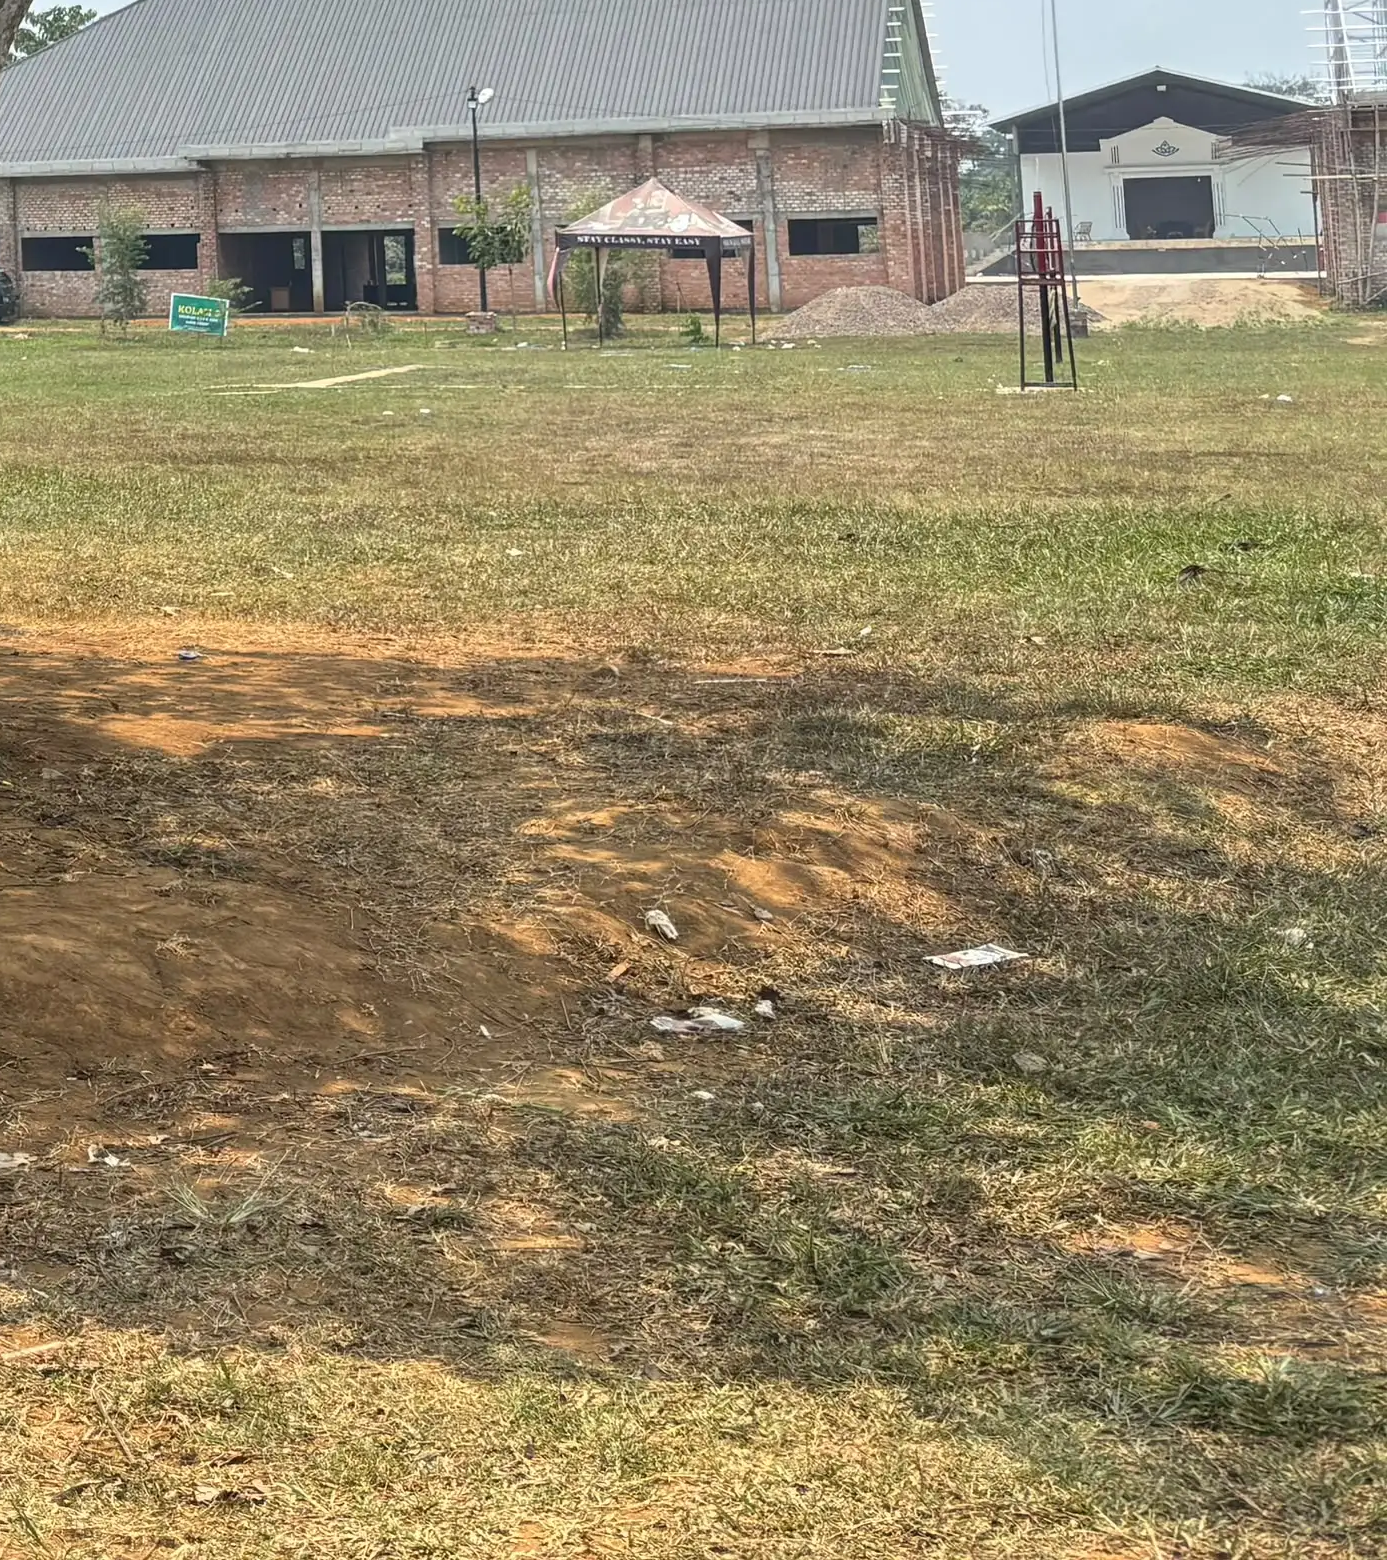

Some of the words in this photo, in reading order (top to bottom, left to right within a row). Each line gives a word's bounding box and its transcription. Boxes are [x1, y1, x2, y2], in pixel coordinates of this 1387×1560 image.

[577, 235, 602, 244] STAY
[647, 236, 672, 246] STAY
[674, 236, 702, 246] EASY
